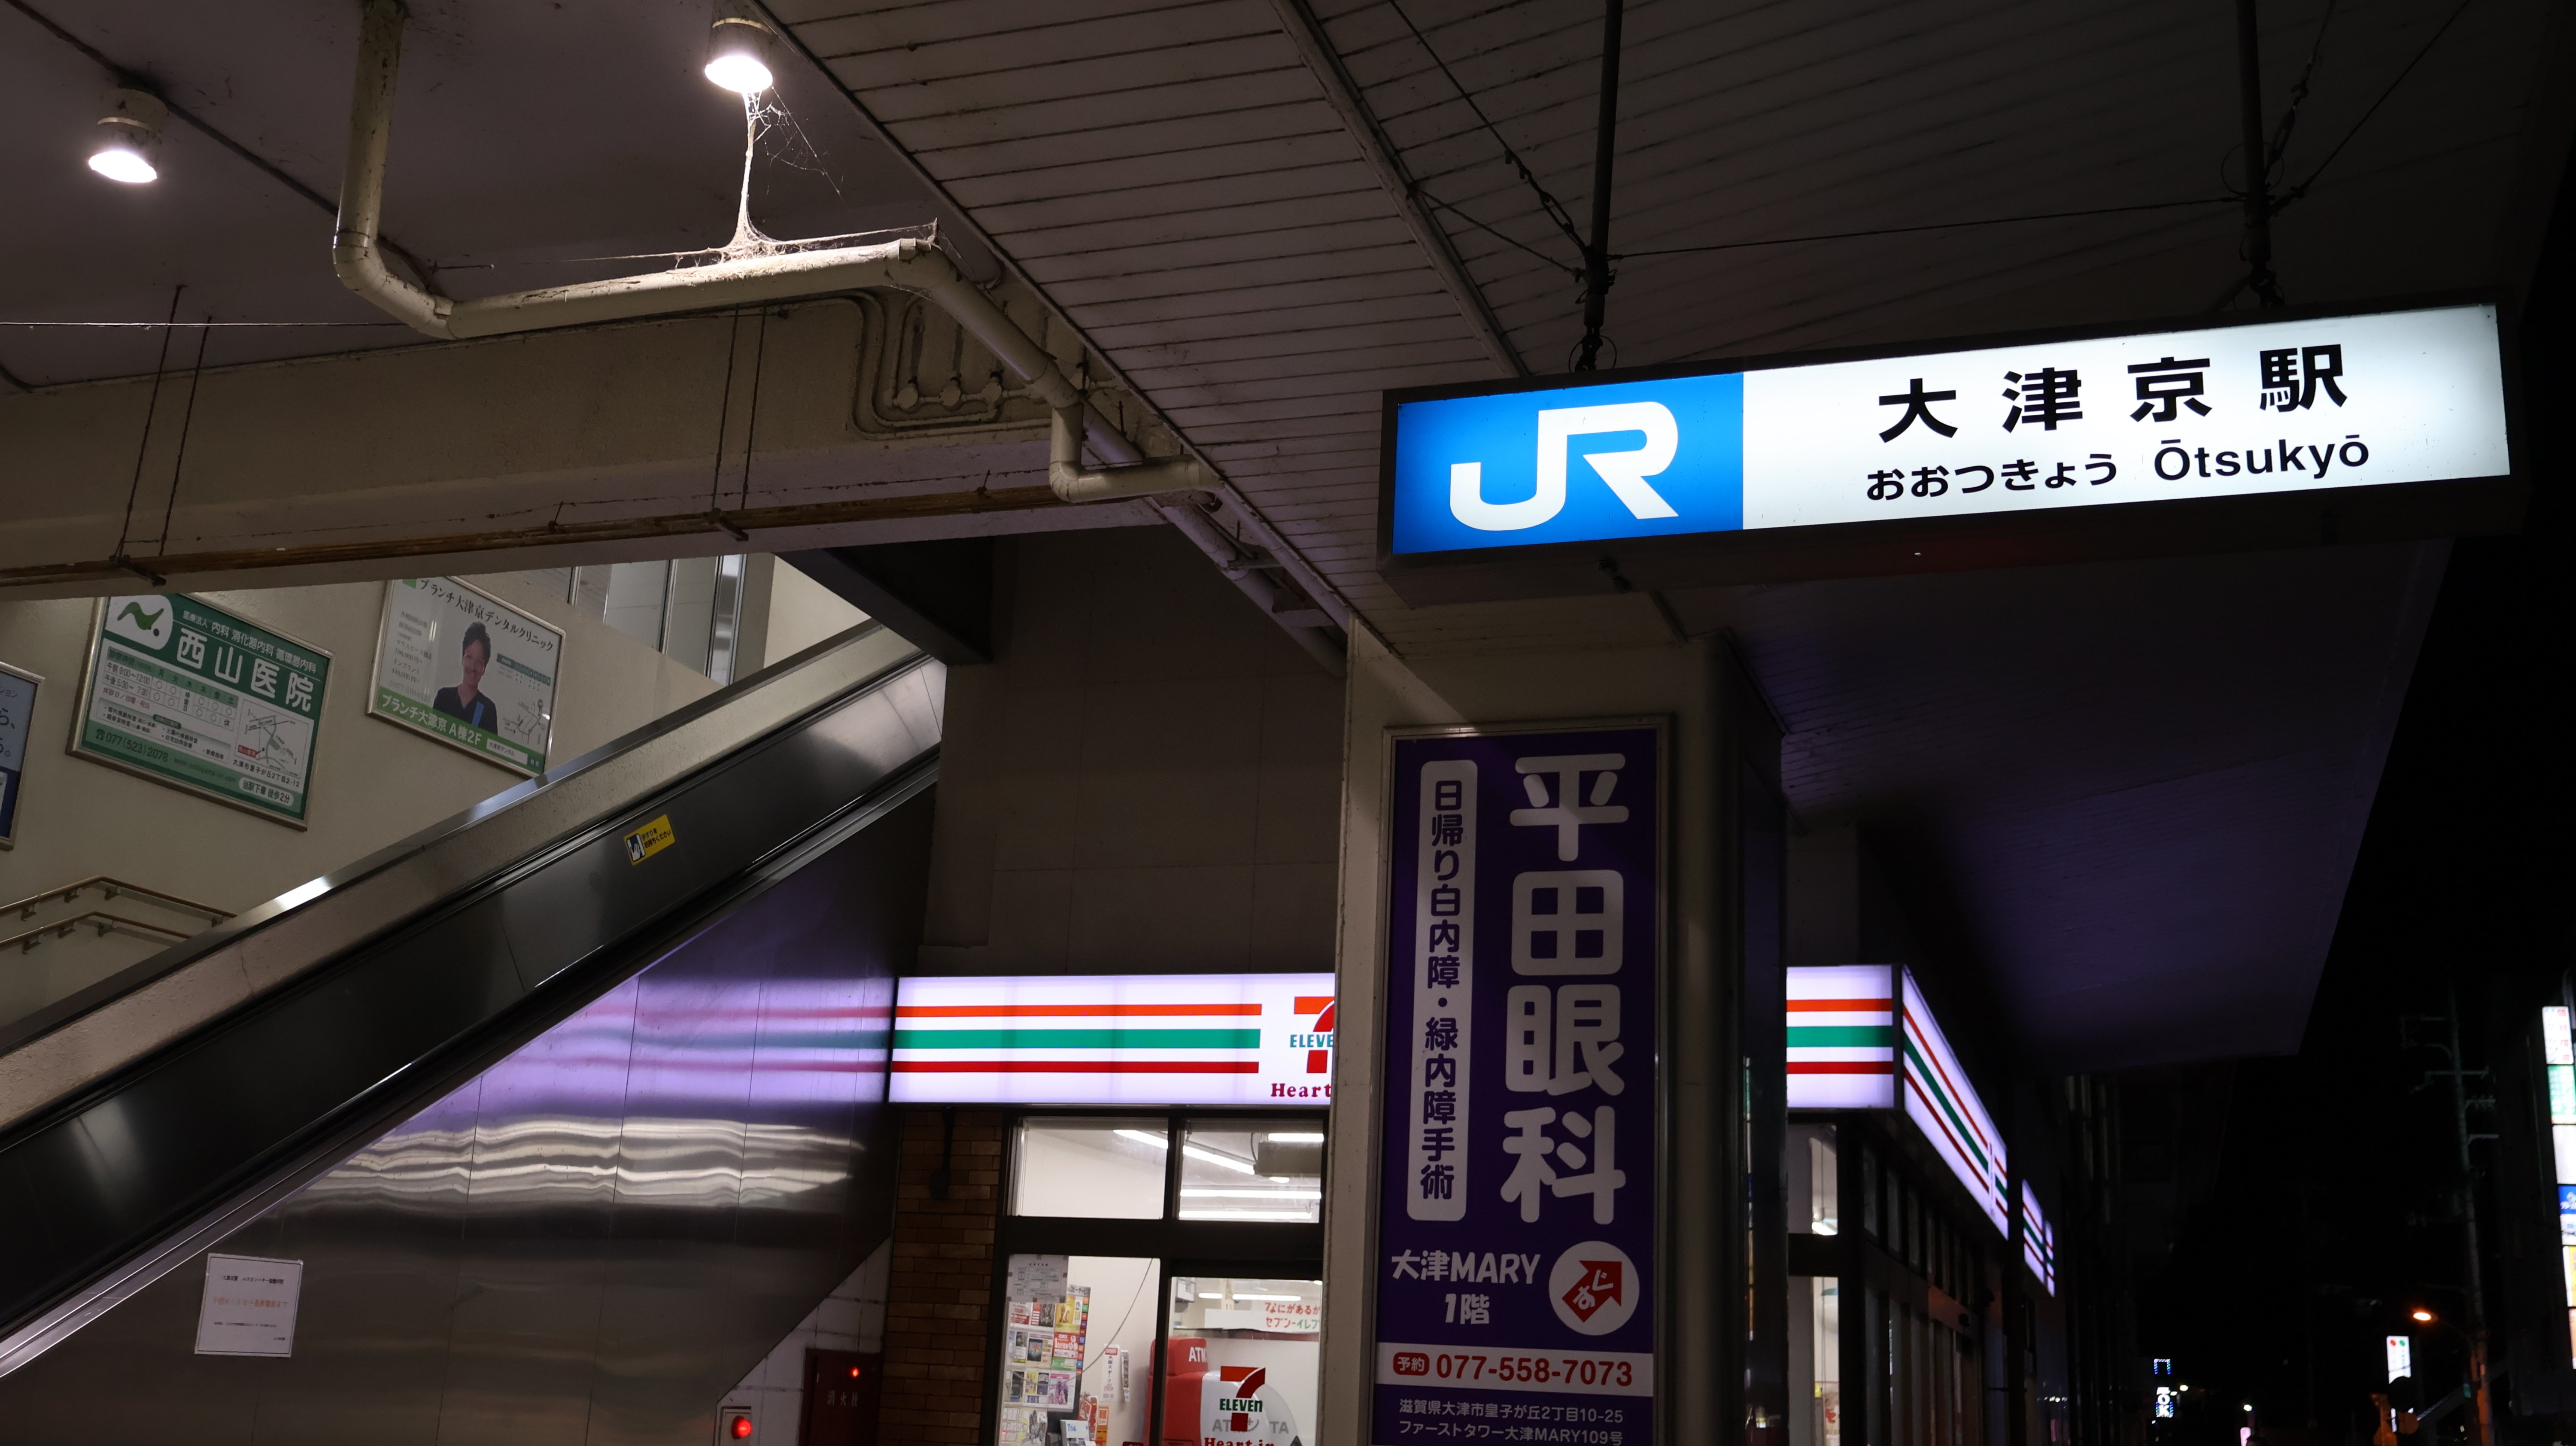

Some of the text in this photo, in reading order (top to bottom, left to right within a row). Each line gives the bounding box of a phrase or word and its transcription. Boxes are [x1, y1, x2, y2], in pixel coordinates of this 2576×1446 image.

[1878, 343, 2348, 443] 大津京駅
[1450, 401, 1679, 531] JR
[1867, 434, 2369, 501] おおつきょう Ōtsukyō
[211, 622, 229, 638] 内科
[231, 629, 274, 656] 消化器内科
[177, 628, 313, 712] 西山医院
[382, 694, 448, 732] ブランチ大津京
[1420, 780, 1463, 1200] 日帰り白内障・緑内障手術
[1500, 753, 1629, 1225] 平田眼科
[1271, 1083, 1331, 1097] Heart
[1391, 1249, 1541, 1285] 大津MARY
[1572, 1269, 1613, 1310] すぐ
[1445, 1293, 1490, 1324] 1階
[1397, 1354, 1632, 1387] 予約 077-558-7073
[827, 1389, 859, 1407] 消火栓
[1399, 1398, 1623, 1423] 滋賀県大津市皇子が丘2丁目10-25
[1399, 1421, 1623, 1446] ファーストタワー大津MARY109号
